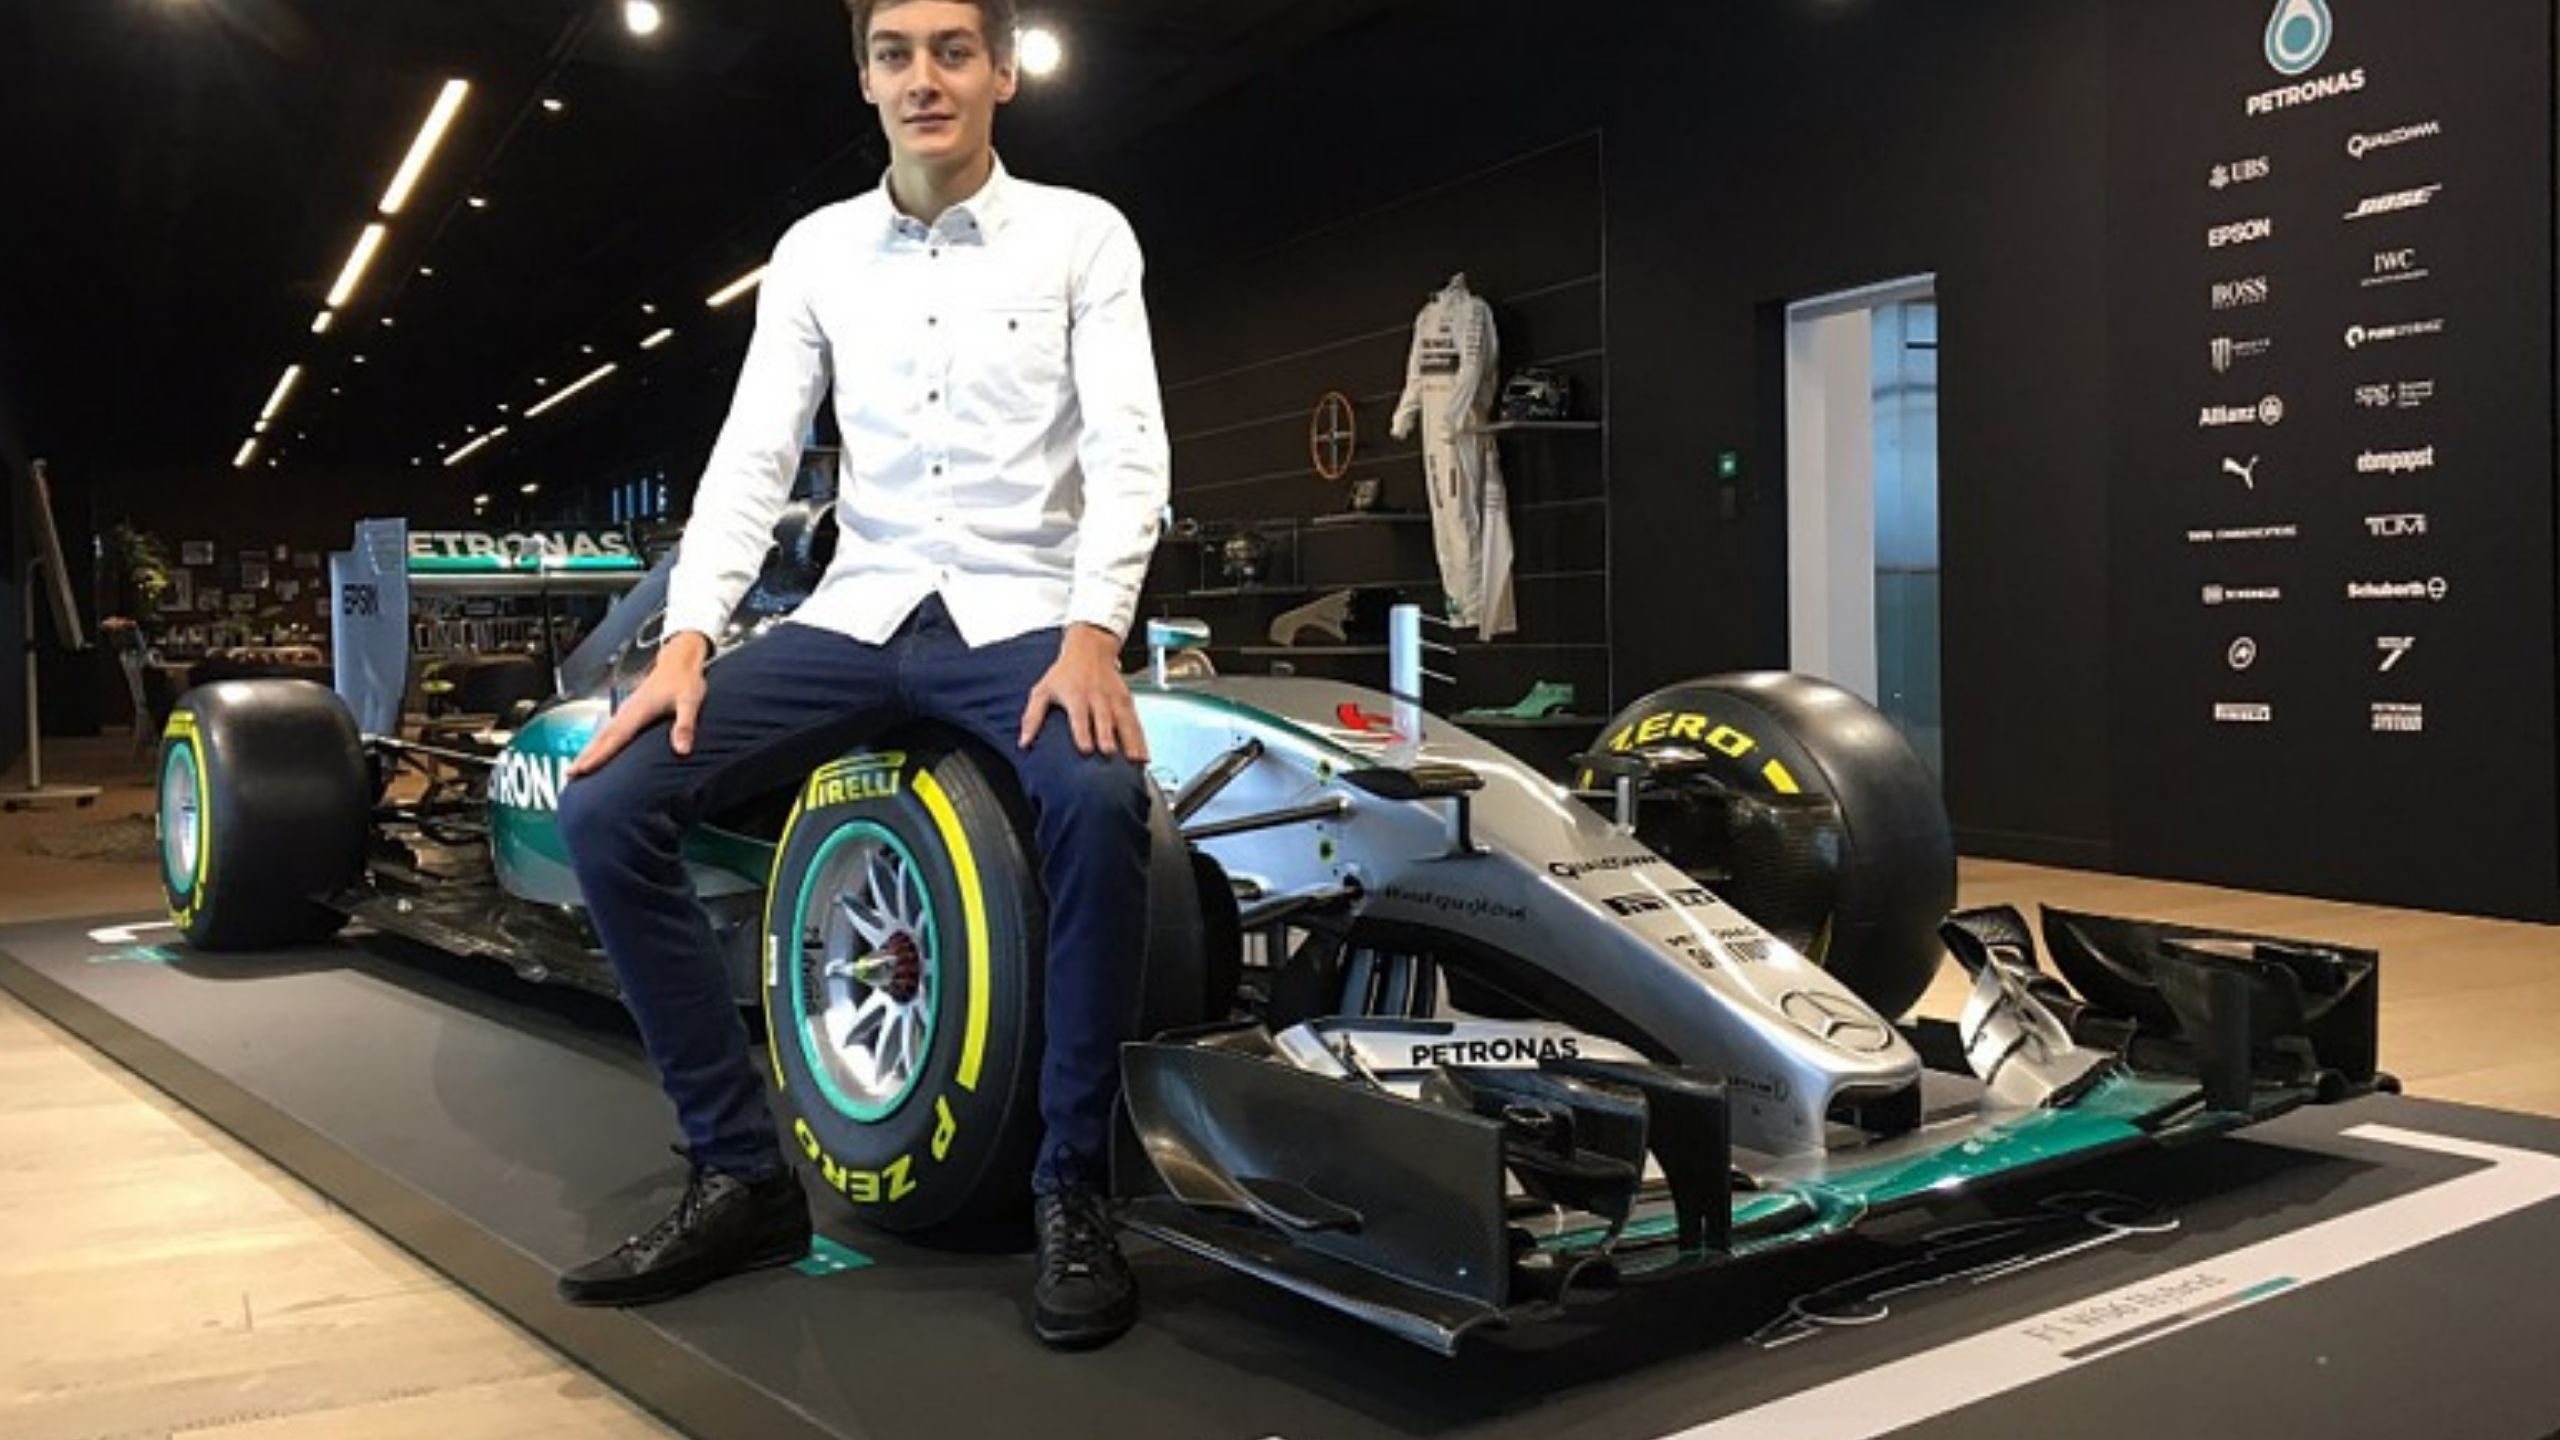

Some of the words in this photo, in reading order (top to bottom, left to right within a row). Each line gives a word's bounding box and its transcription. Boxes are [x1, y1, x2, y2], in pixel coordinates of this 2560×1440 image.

[2246, 67, 2366, 117] PETRONAS
[2231, 156, 2270, 182] UBS
[2208, 217, 2271, 247] EPSON
[2374, 248, 2416, 274] IWC
[2199, 405, 2257, 426] Allianz
[406, 530, 632, 558] ETRONAS
[806, 750, 907, 810] PIRELLI
[1411, 1037, 1580, 1067] PETRONAS
[794, 1117, 917, 1203] ZERO
